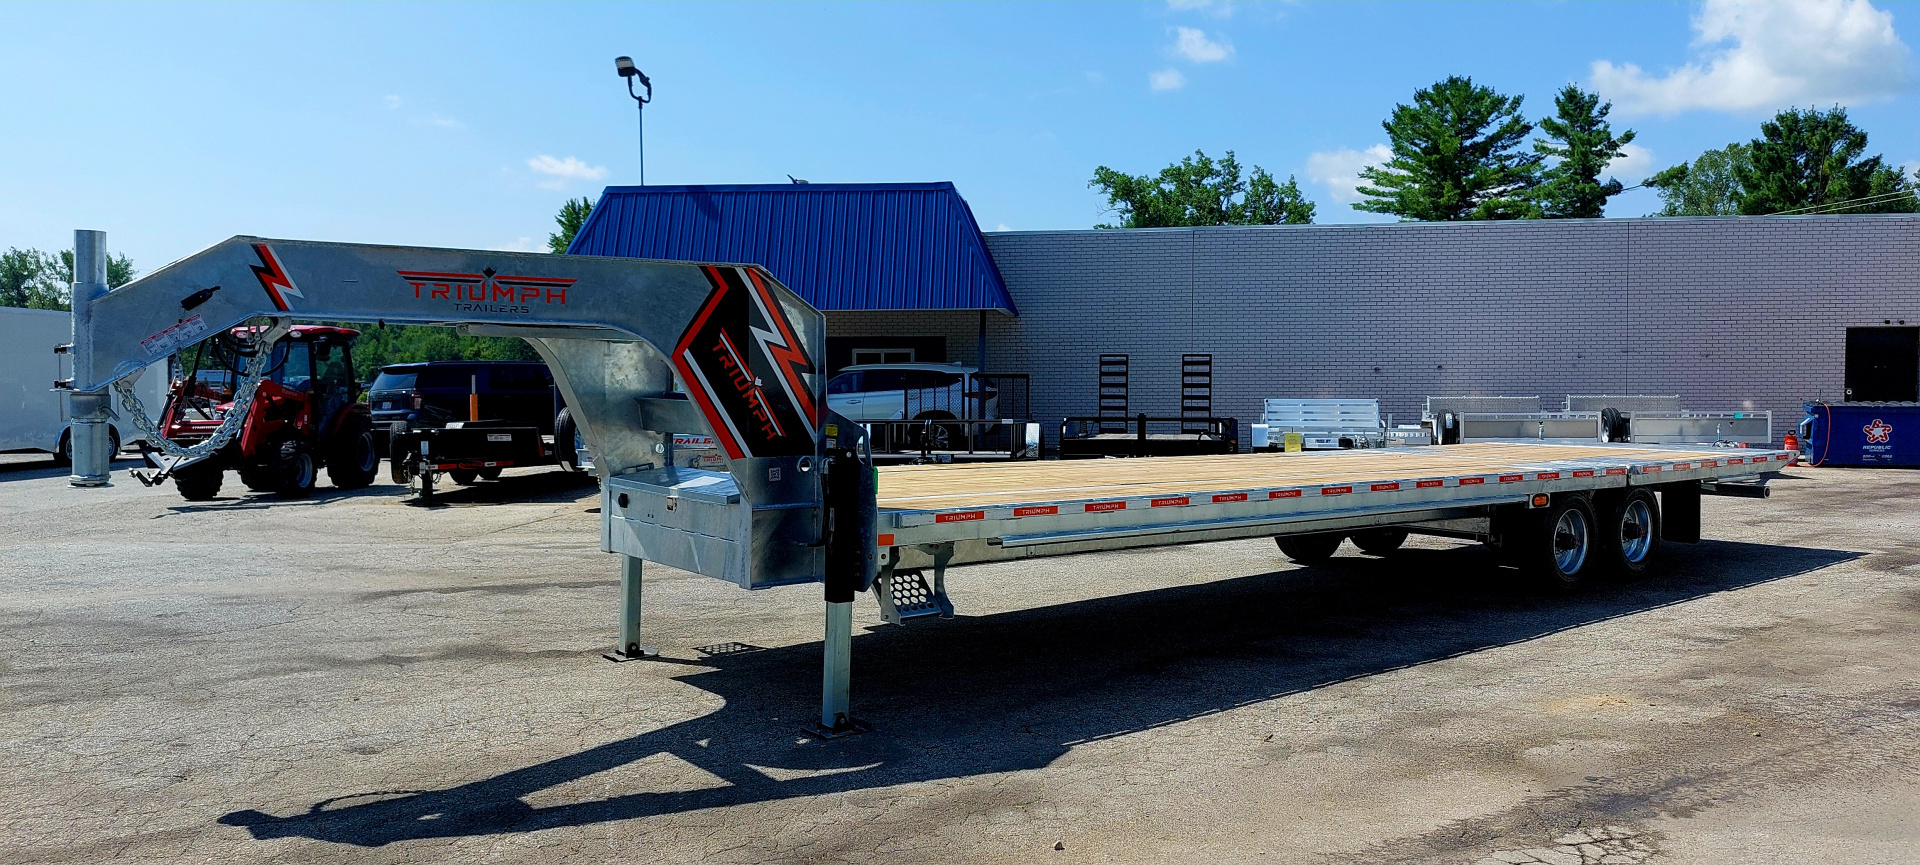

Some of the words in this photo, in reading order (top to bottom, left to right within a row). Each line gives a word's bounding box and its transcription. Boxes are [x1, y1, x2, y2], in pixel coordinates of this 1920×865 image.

[408, 281, 567, 304] TRIUMPH
[453, 303, 530, 314] TRAILERS
[712, 338, 777, 440] TRIUMPH
[1021, 507, 1050, 515] TRIUMPH
[944, 513, 976, 521] TRIUMPH
